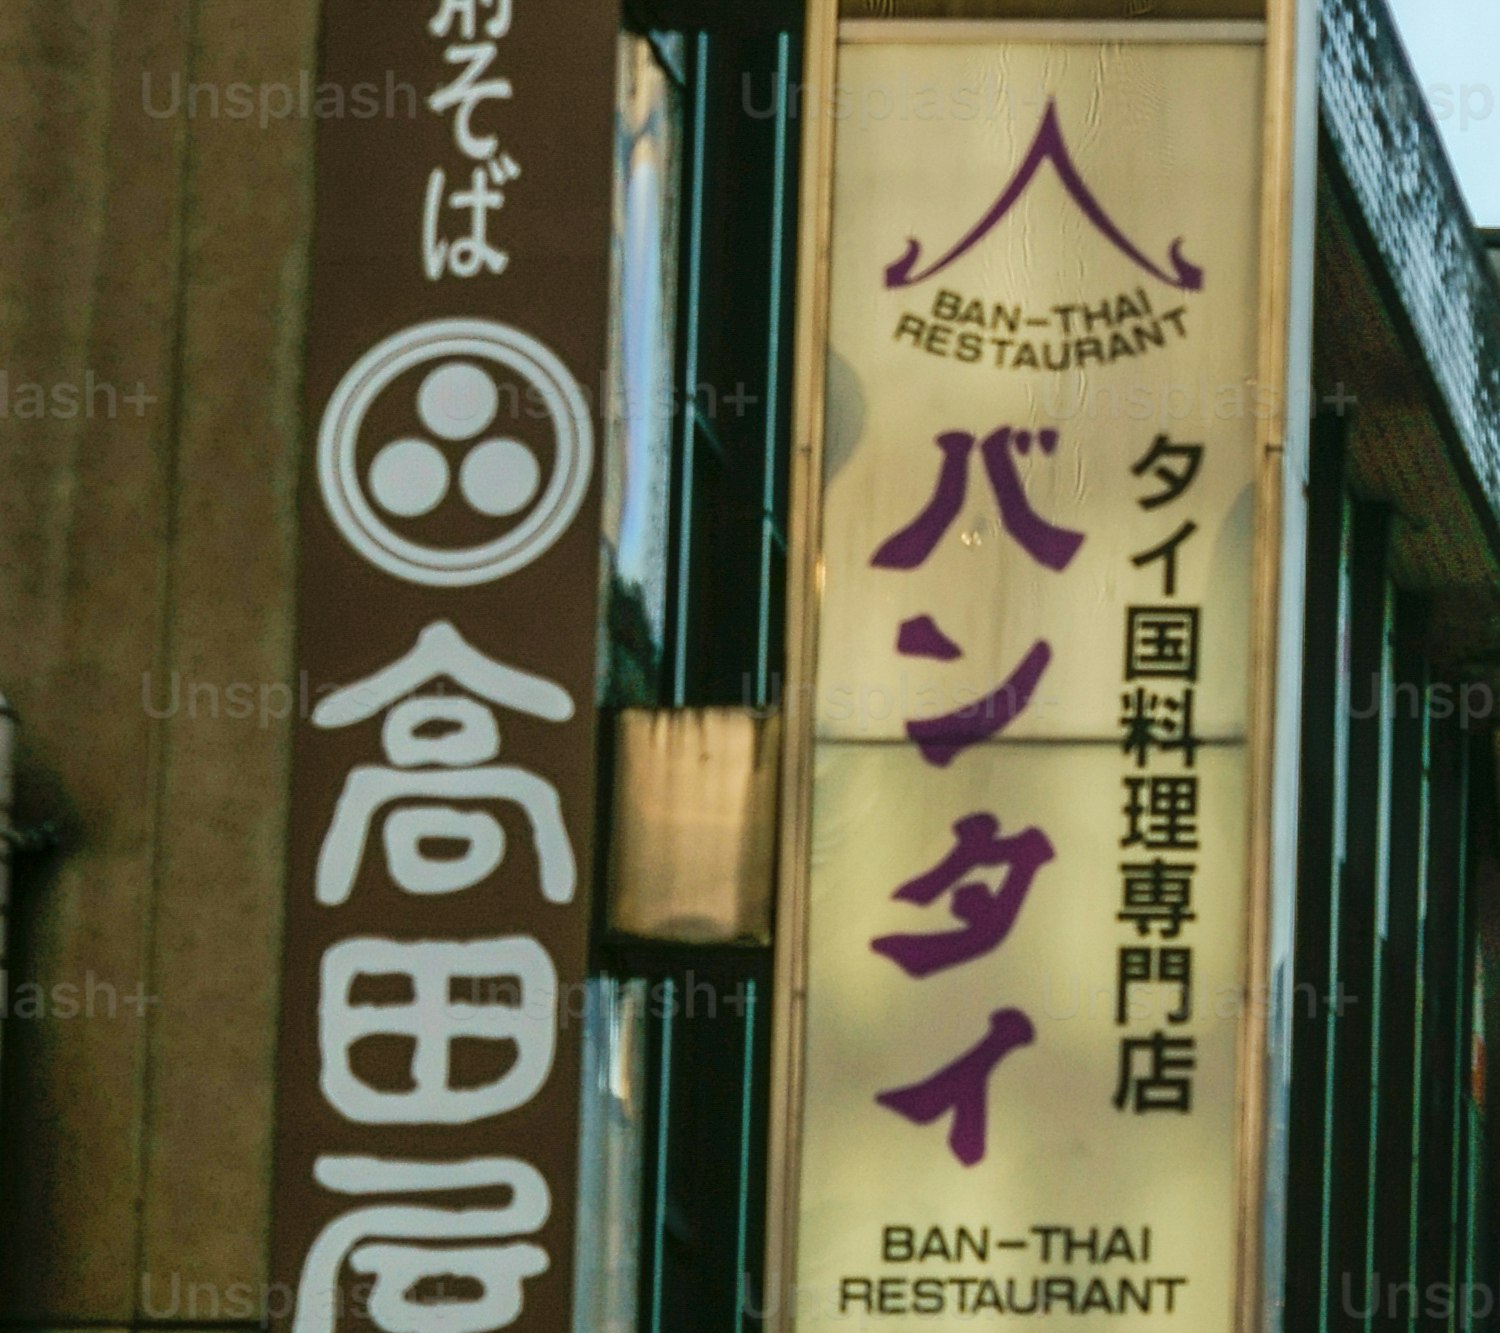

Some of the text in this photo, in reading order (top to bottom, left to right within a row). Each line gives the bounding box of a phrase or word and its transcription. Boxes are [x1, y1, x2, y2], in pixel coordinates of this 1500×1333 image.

[892, 305, 1193, 373] RESTAURANT
[869, 424, 1087, 1169] バンタイ
[1110, 430, 1206, 1117] タイ国料理専門店
[838, 1277, 1188, 1316] RESTAURANT
